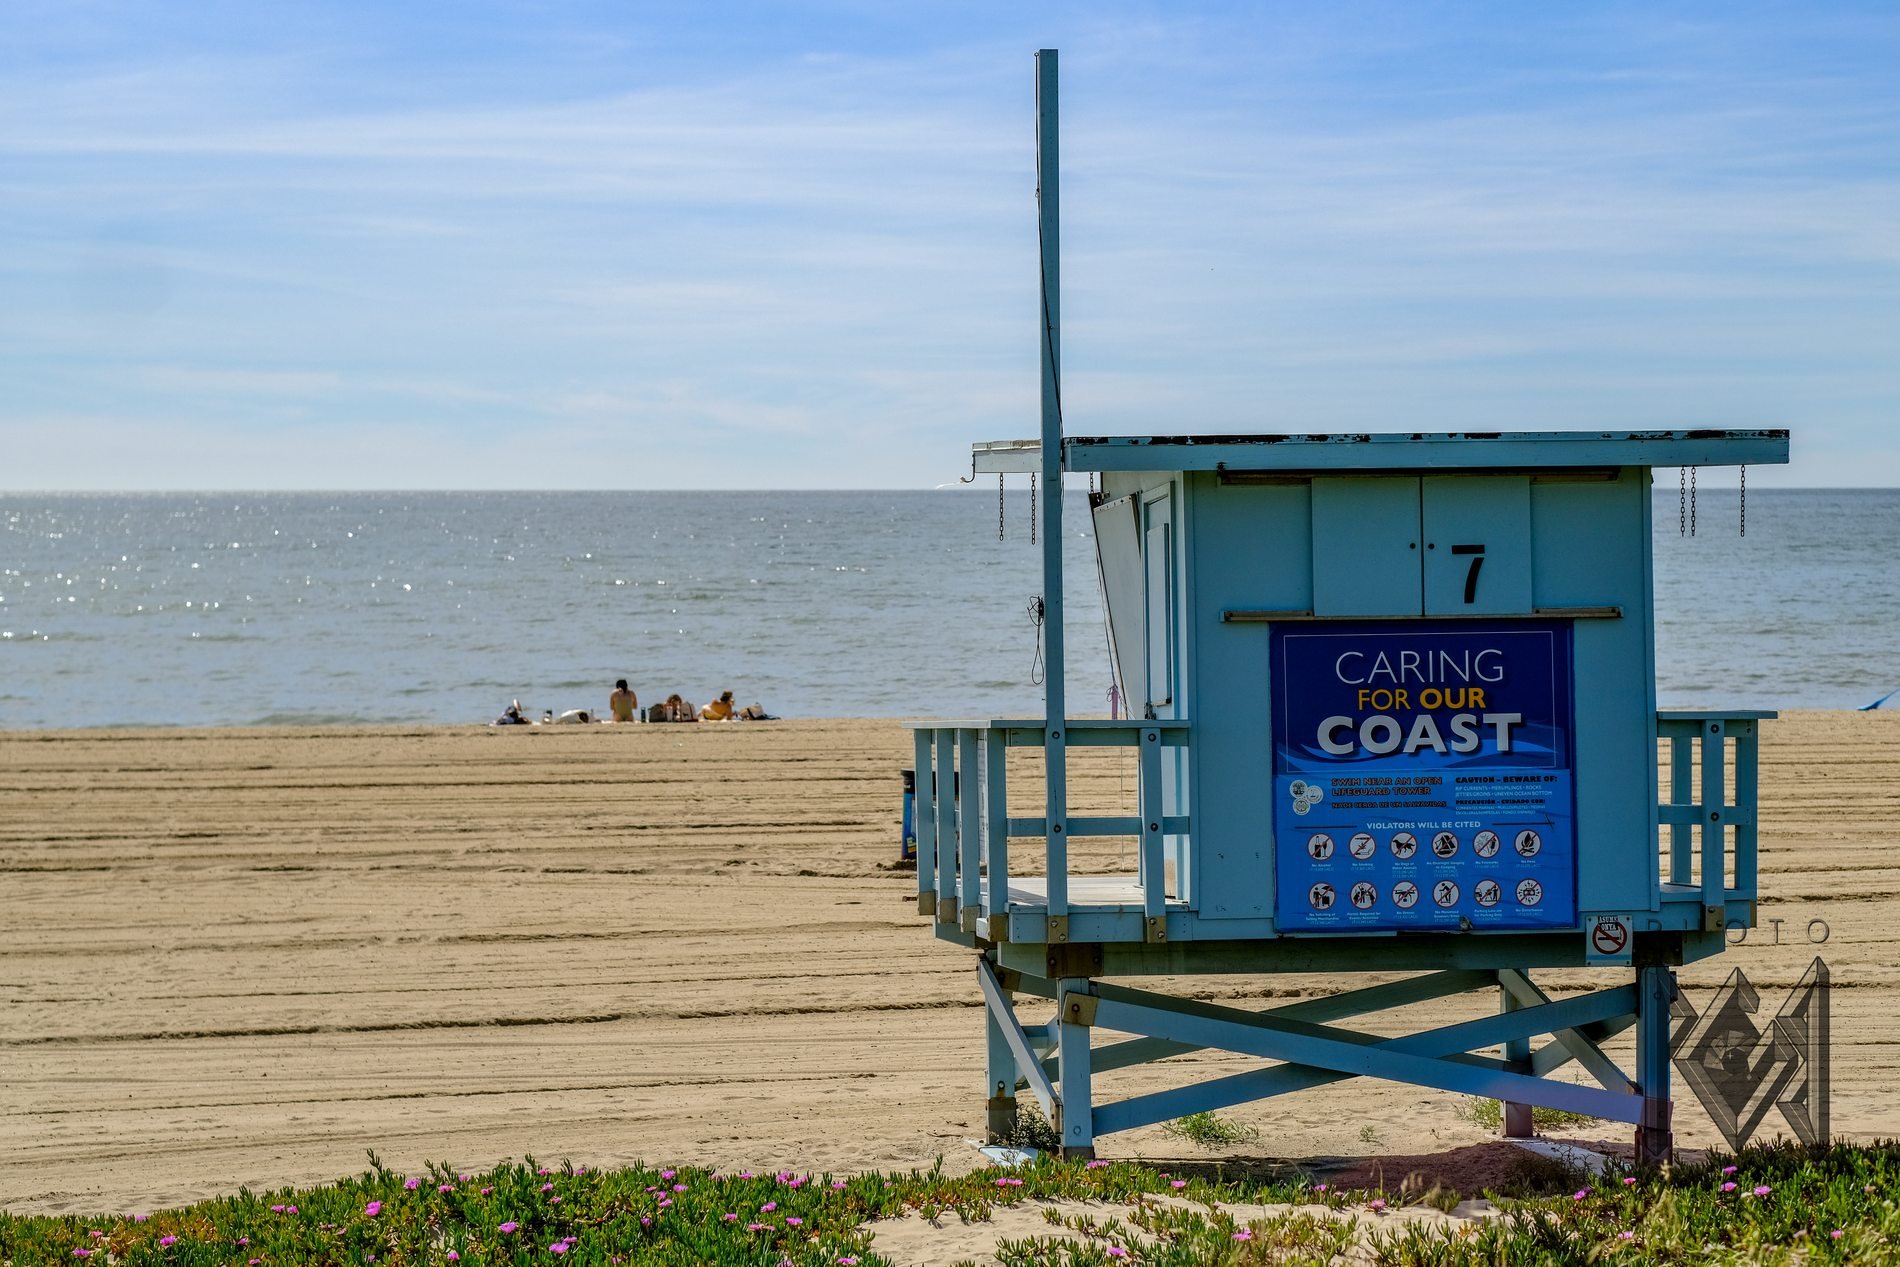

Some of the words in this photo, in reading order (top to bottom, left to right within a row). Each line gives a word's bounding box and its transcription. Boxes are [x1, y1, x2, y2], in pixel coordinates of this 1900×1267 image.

[1452, 545, 1485, 604] 7
[1335, 649, 1504, 684] CARING
[1358, 689, 1411, 710] FOR
[1419, 687, 1486, 709] OUR
[1316, 712, 1522, 755] COAST
[1332, 778, 1360, 786] SWIM
[1363, 777, 1392, 786] NEAR
[1395, 776, 1411, 786] AN
[1414, 776, 1442, 785] OPEN
[1332, 788, 1390, 796] LIFEGUARD
[1392, 786, 1432, 796] TOWER
[1366, 822, 1416, 830] VIOLATORS
[1454, 820, 1481, 828] CITED
